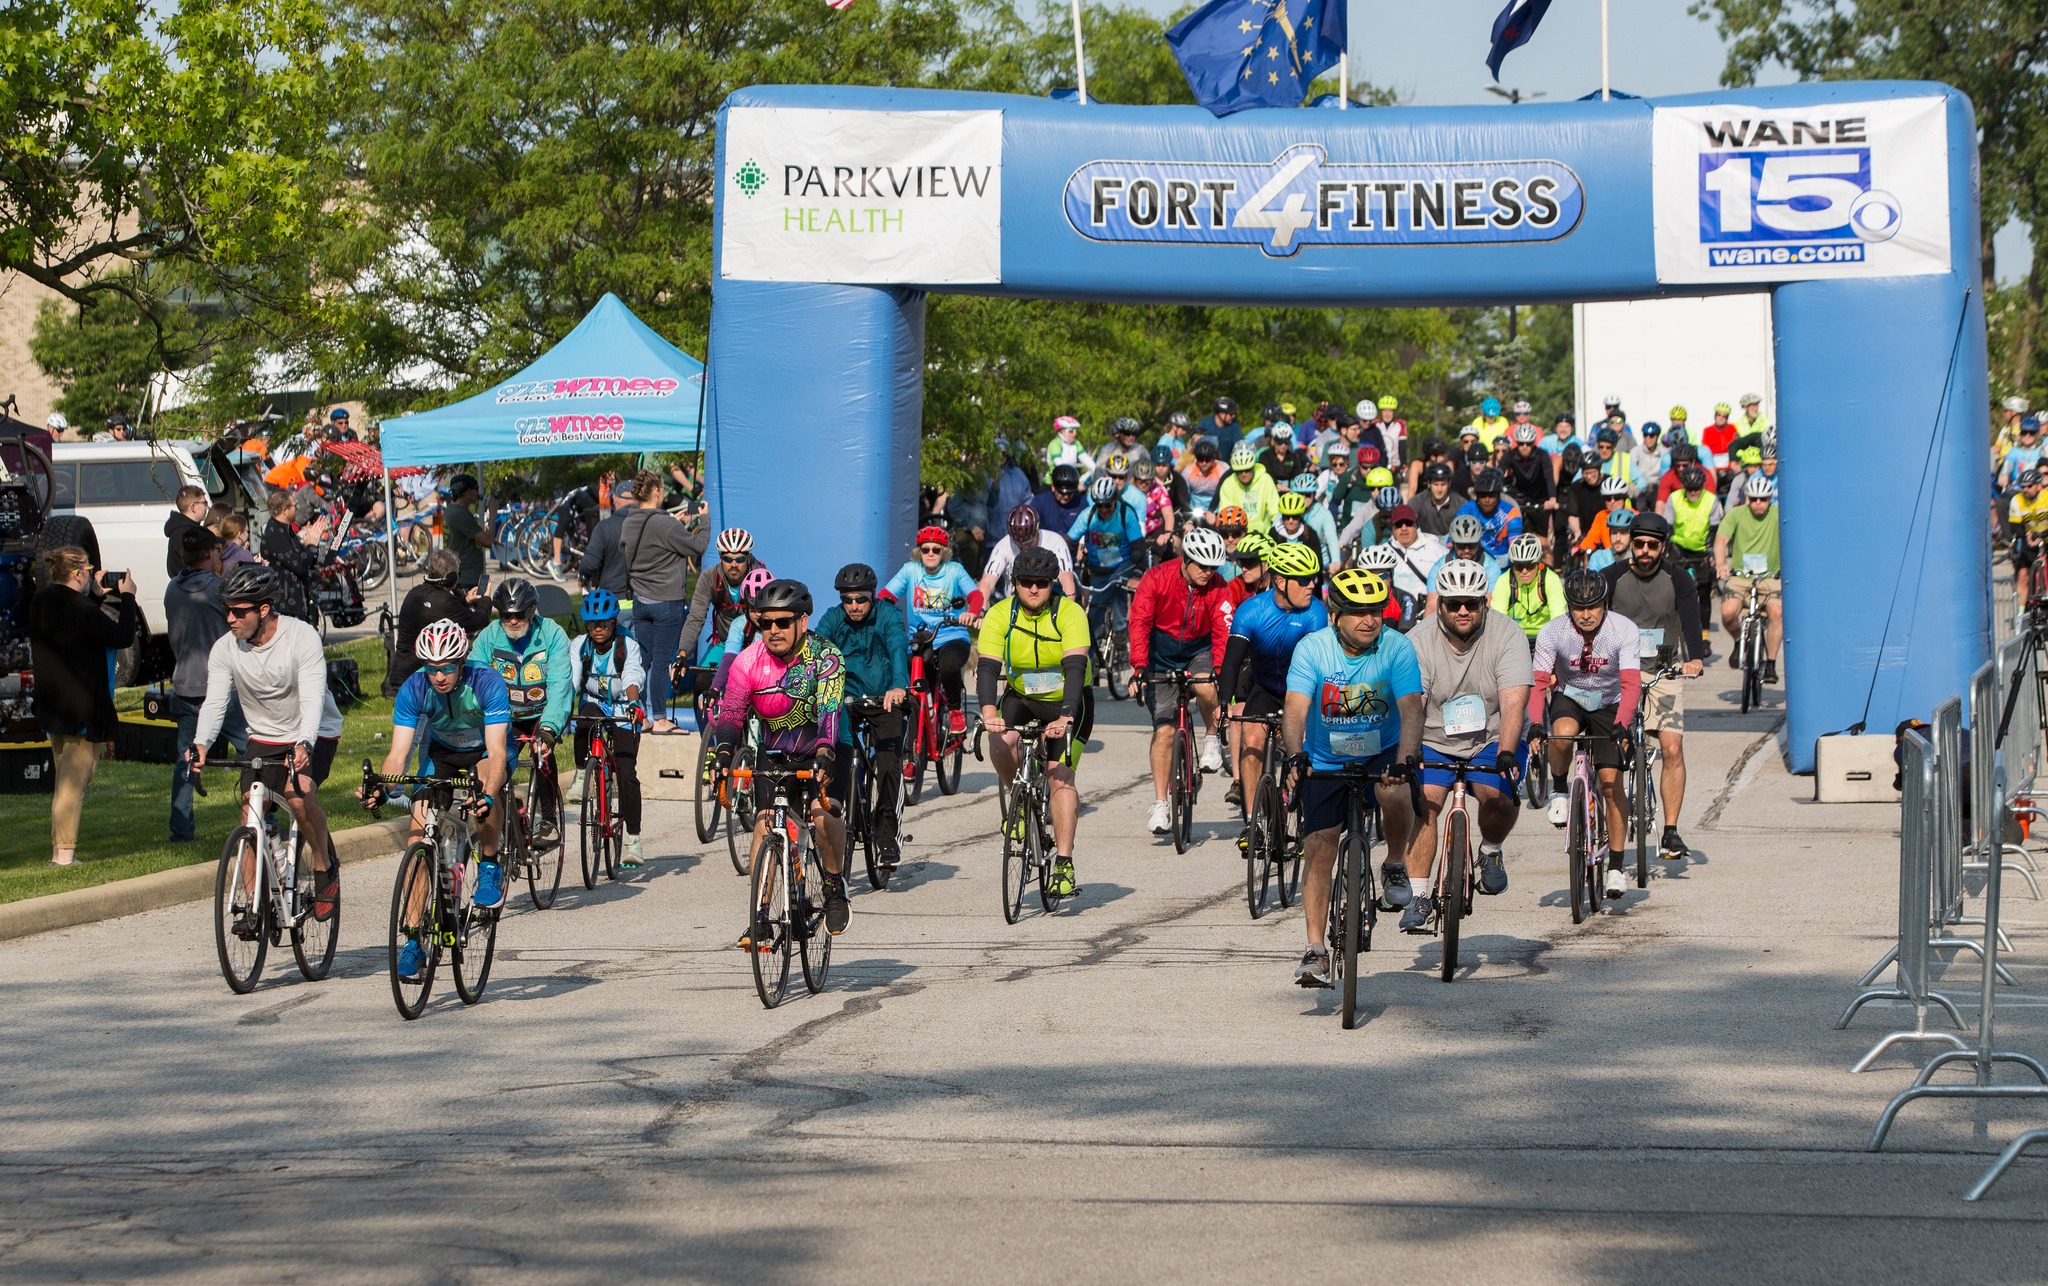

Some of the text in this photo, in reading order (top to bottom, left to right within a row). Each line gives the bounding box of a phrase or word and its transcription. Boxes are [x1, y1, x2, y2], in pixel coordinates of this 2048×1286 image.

[1703, 117, 1867, 148] WANE
[783, 165, 992, 198] PARKVIEW
[1705, 153, 1864, 232] 15
[1092, 154, 1559, 247] FORT 4 FITNESS
[783, 207, 904, 233] HEALTH
[1712, 244, 1862, 265] wane.com
[519, 431, 624, 444] Today's Best Variety
[1321, 714, 1358, 724] SPRING
[1360, 712, 1391, 723] CYCLE
[1455, 706, 1475, 719] 290
[1344, 742, 1365, 751] 291
